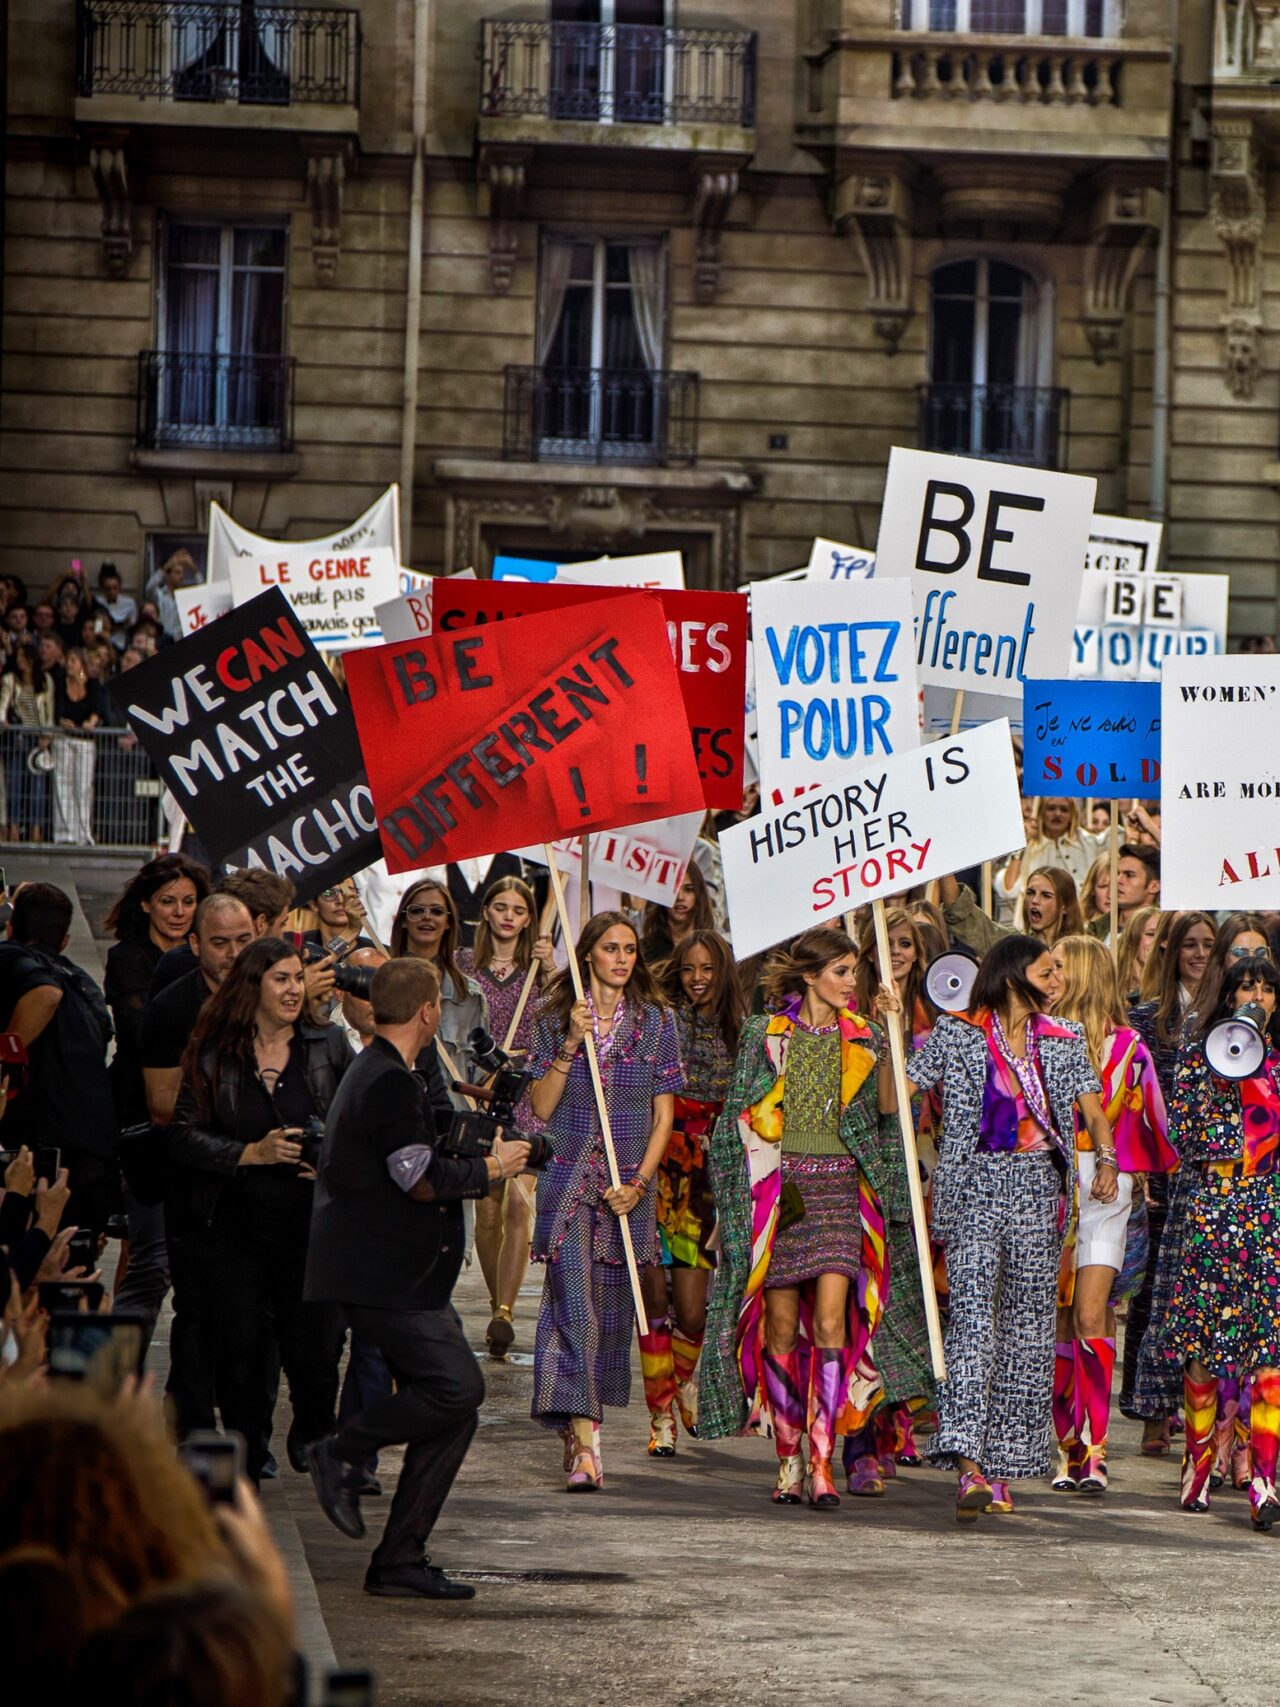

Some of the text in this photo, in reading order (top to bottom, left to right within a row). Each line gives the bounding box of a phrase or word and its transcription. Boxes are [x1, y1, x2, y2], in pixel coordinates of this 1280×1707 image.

[916, 479, 1045, 586] BE
[259, 557, 371, 585] LE GENRE
[333, 587, 365, 610] pas
[1112, 581, 1174, 619] BE
[301, 612, 349, 630] auvais
[765, 621, 901, 686] VOTEZ
[914, 589, 1035, 683] ifferent
[128, 616, 306, 735] WE CAN
[392, 637, 493, 705] BE
[168, 670, 337, 796] MATCH
[382, 637, 634, 862] DIFFERENT
[778, 695, 894, 760] POUR
[1034, 701, 1060, 741] Je
[245, 753, 316, 807] THE
[1043, 755, 1161, 787] SOLD
[1178, 781, 1226, 800] ARE
[750, 747, 969, 864] HISTORY IS
[834, 811, 912, 864] HER
[812, 838, 931, 911] STORY
